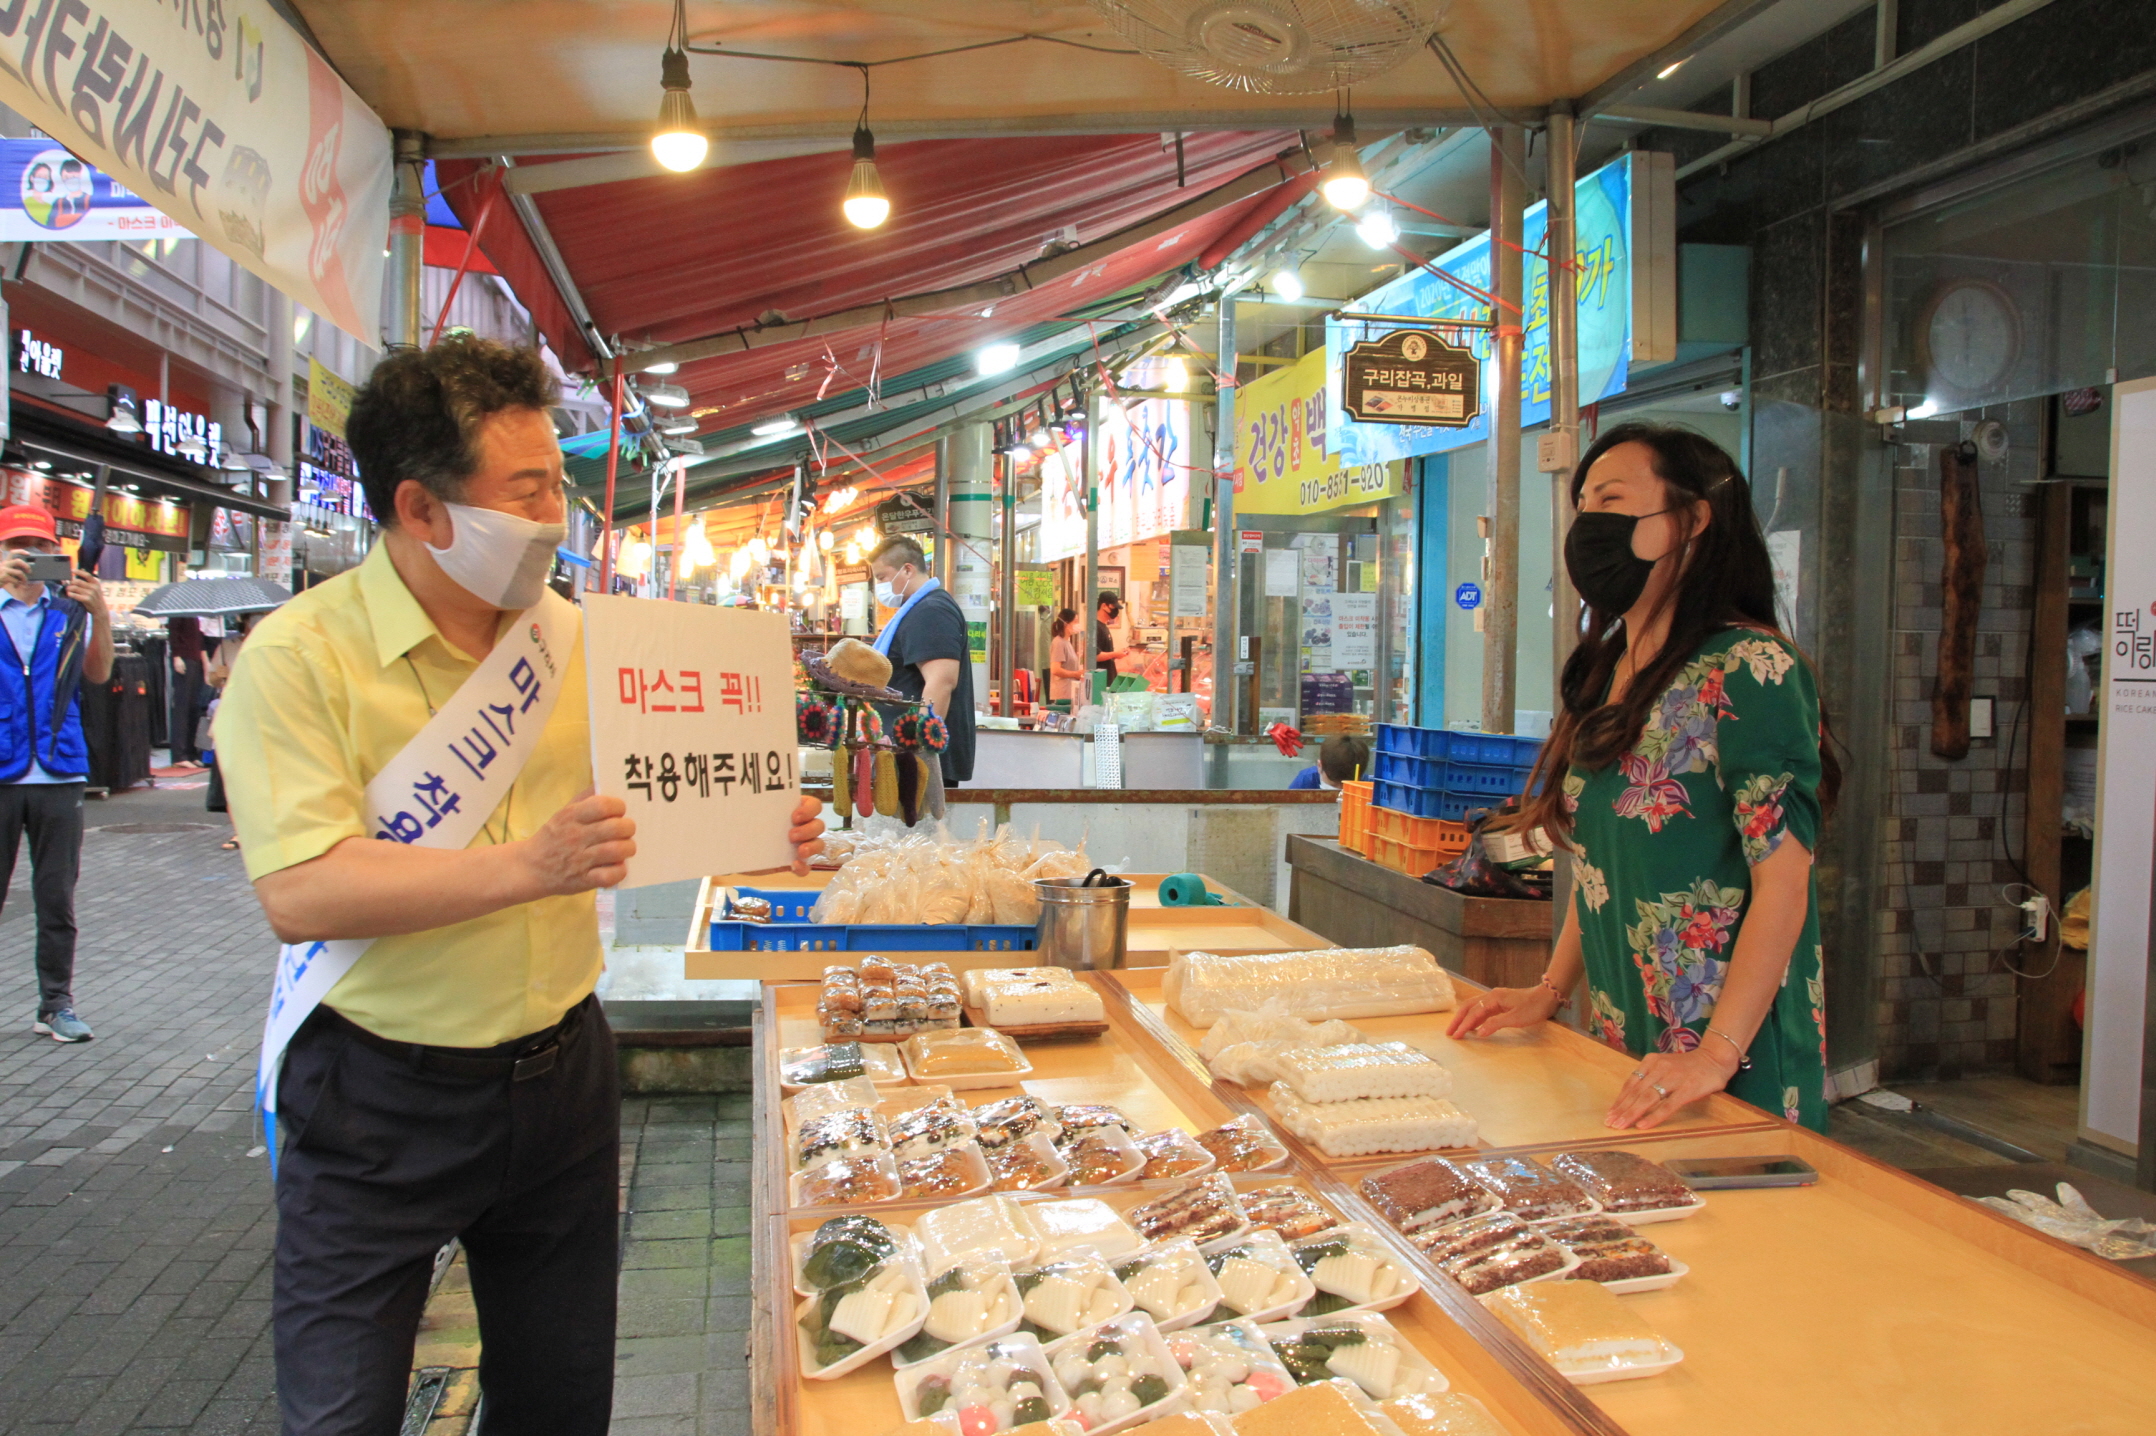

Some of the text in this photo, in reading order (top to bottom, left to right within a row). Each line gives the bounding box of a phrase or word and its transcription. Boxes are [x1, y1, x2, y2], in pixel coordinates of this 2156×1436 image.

[119, 216, 156, 230] 마스크
[1362, 368, 1463, 391] 구리잡곡,과일
[1248, 403, 1289, 484] 건강
[1460, 591, 1478, 602] ADT
[618, 666, 762, 715] 마스크 꼭!!
[448, 655, 543, 782] 마스크
[2116, 704, 2133, 714] RICE
[624, 750, 794, 803] 착용해주세요!
